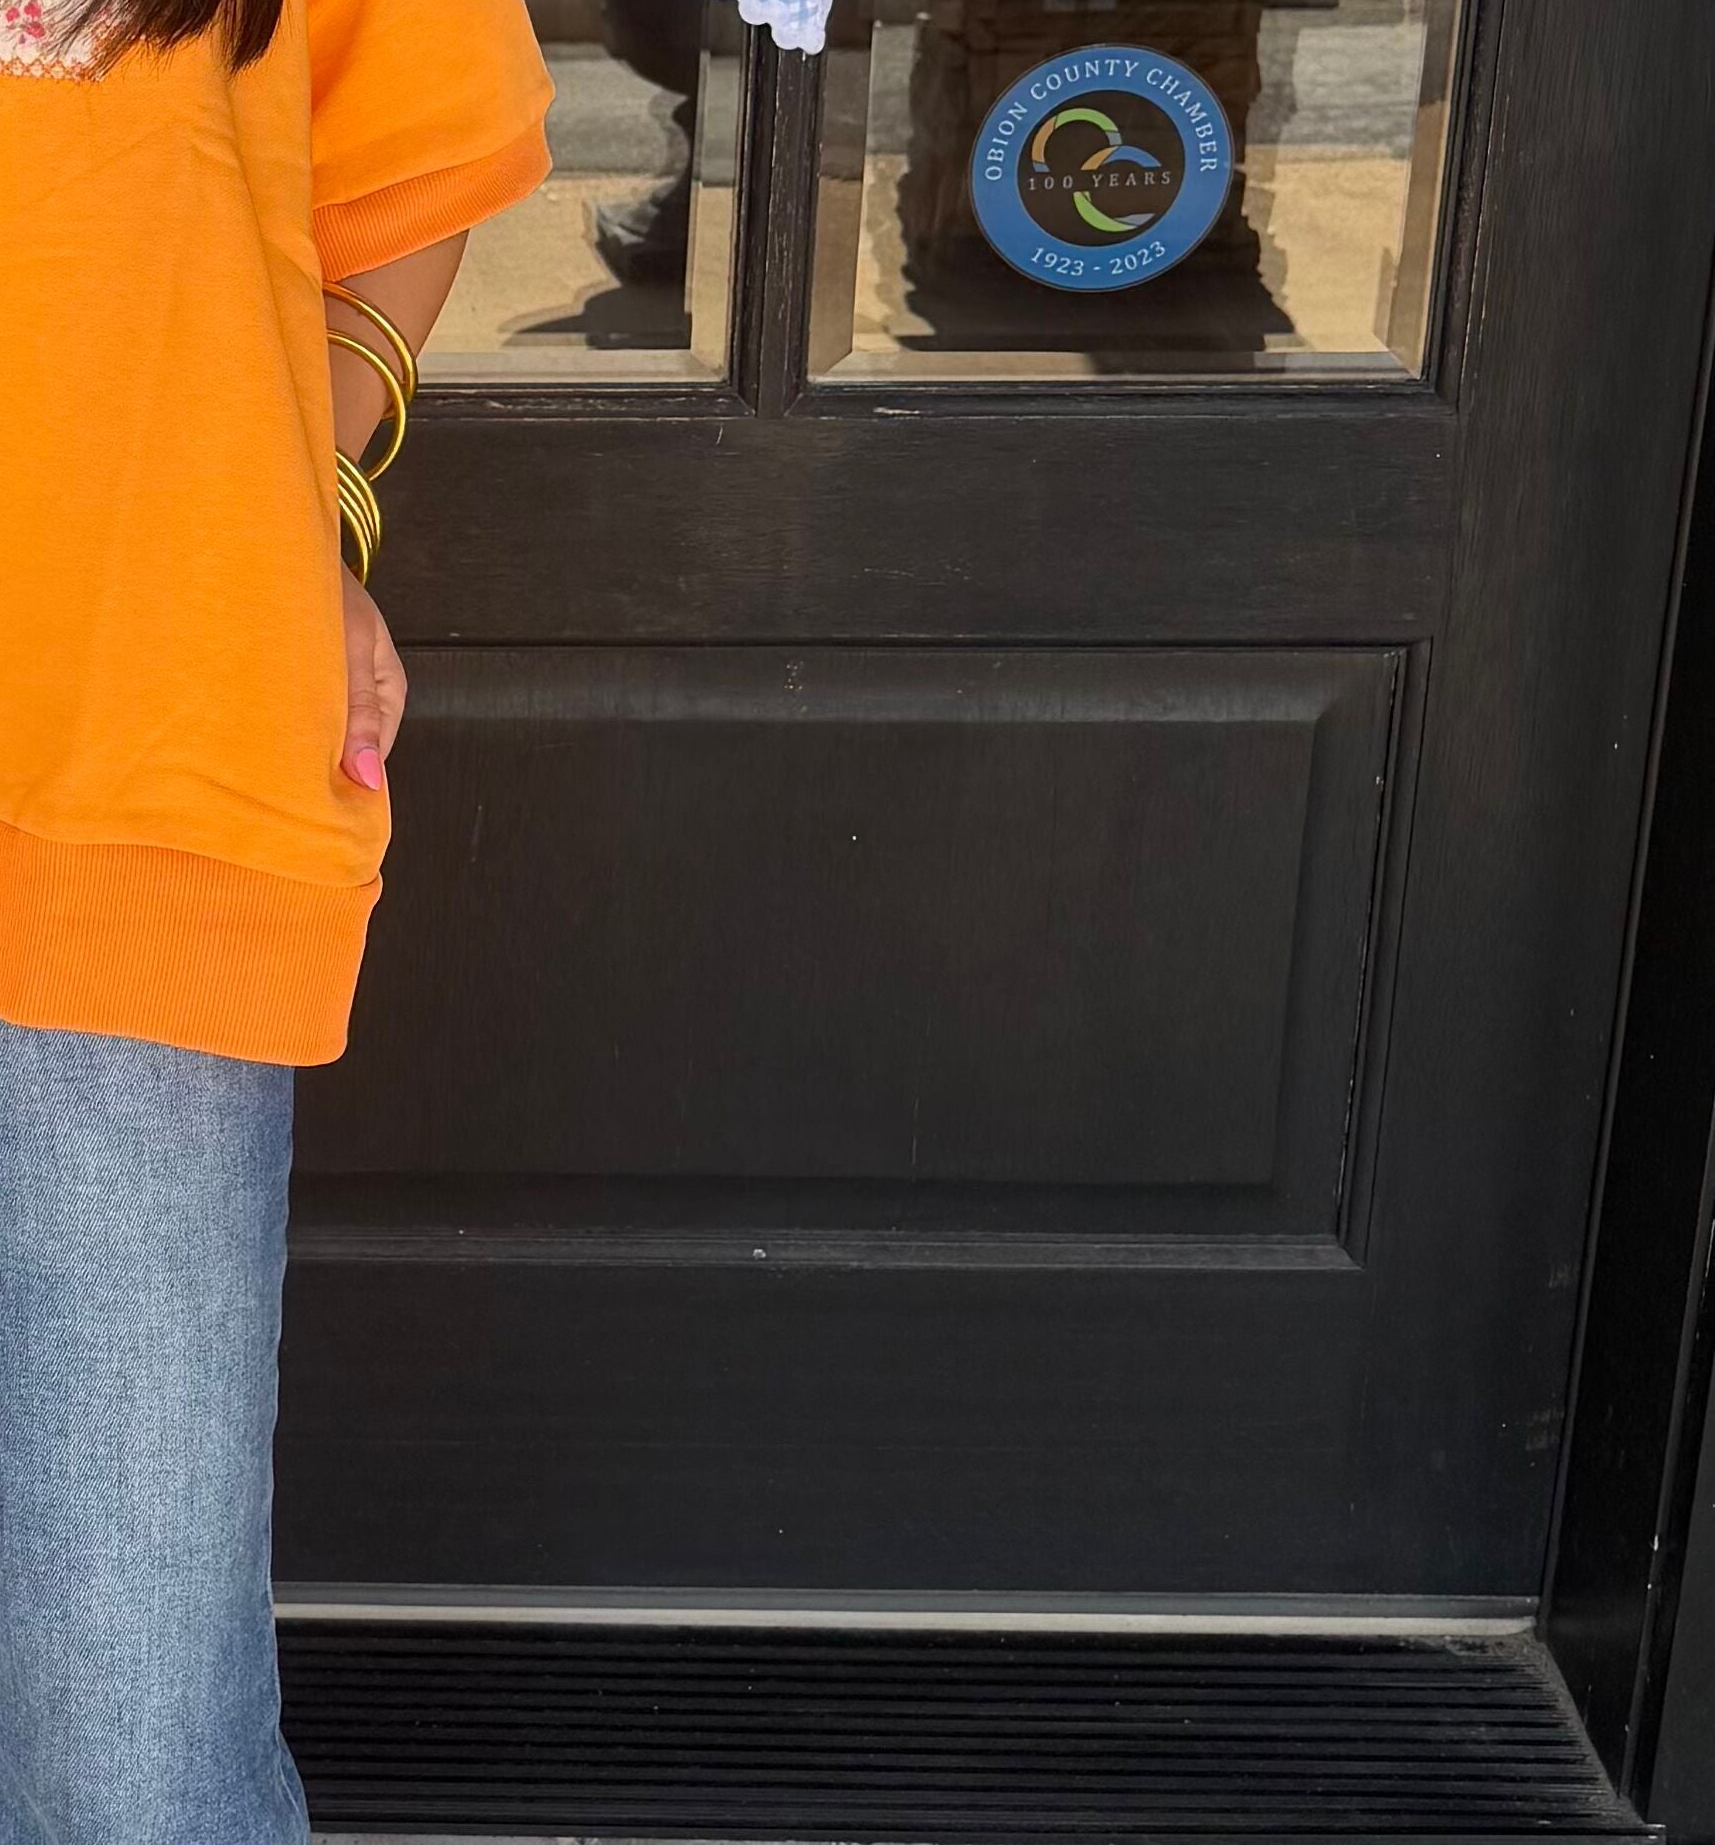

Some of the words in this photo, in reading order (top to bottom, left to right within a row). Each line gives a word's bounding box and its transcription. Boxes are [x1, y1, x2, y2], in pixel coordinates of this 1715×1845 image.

[985, 101, 1028, 182] OBION
[1030, 59, 1139, 101] COUNTY
[1145, 67, 1218, 173] CHAMBER
[1028, 176, 1074, 191] 100
[1092, 171, 1172, 189] YEARS
[1030, 247, 1084, 276] 1923
[1109, 241, 1166, 275] 2023
